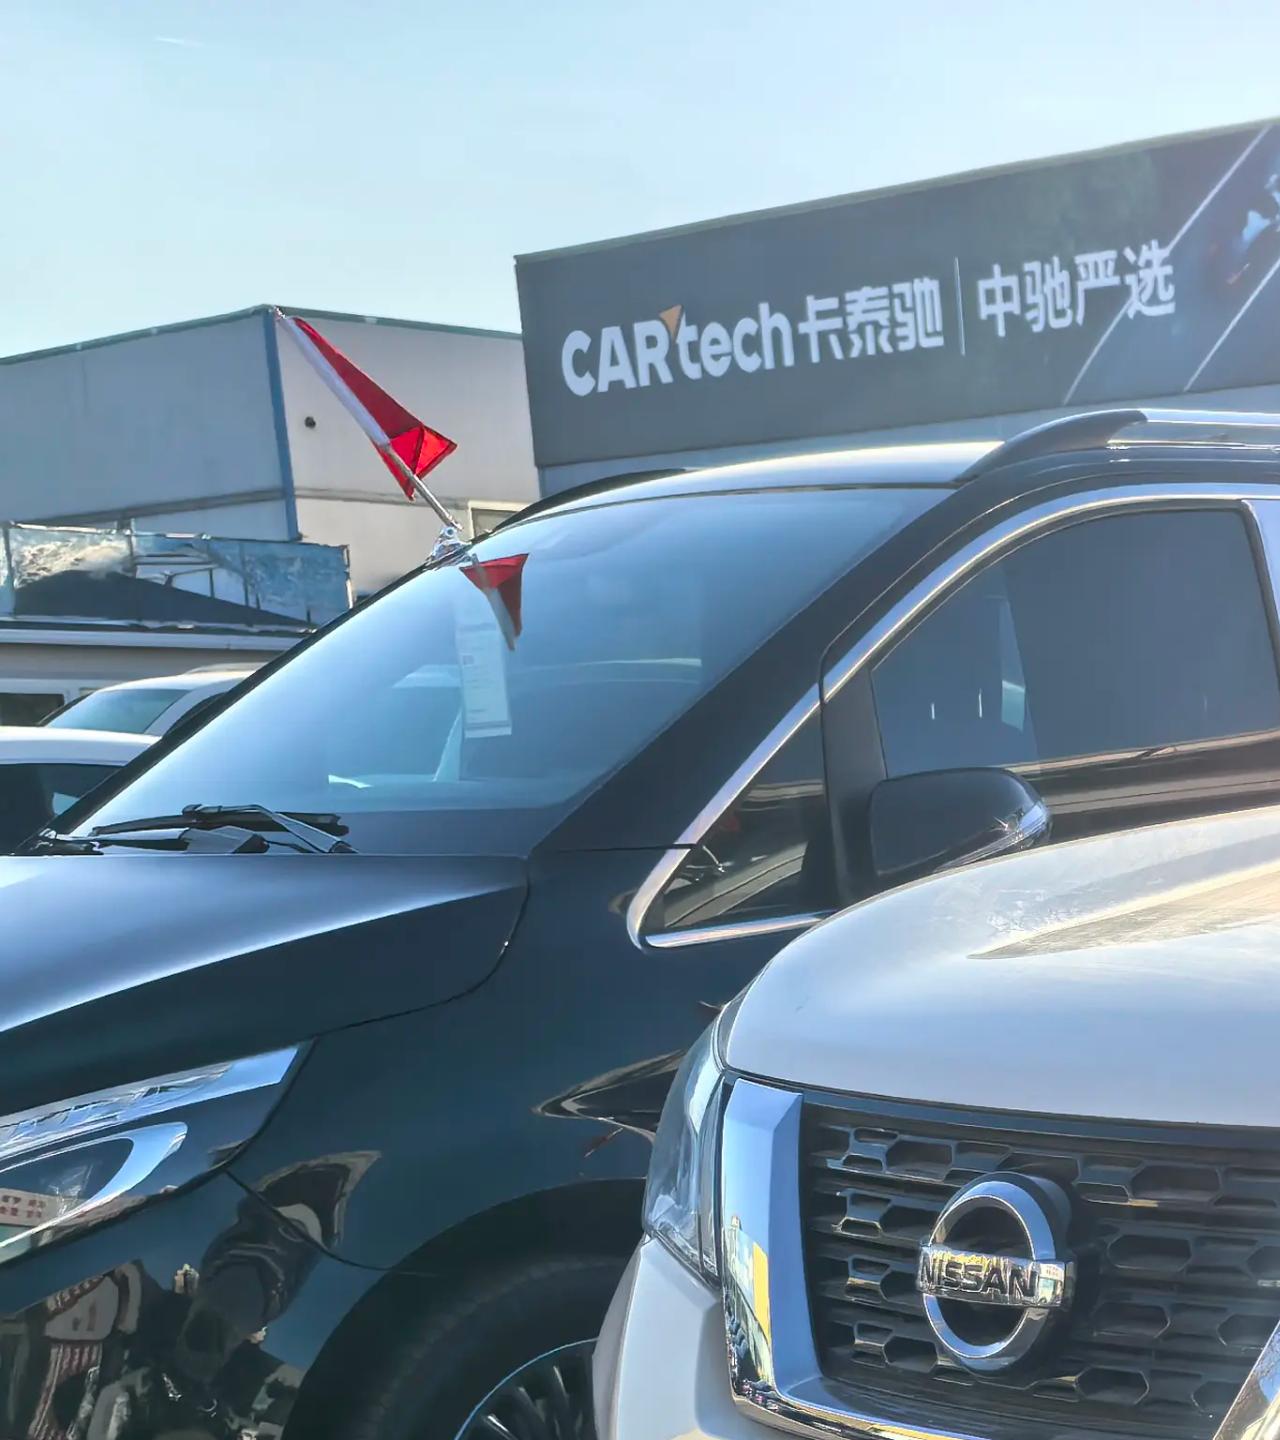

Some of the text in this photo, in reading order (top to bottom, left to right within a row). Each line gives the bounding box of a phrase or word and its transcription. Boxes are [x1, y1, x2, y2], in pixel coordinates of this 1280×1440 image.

[798, 277, 945, 362] 卡泰驰
[976, 239, 1177, 338] 中驰严选
[919, 1250, 1040, 1301] NISSAN
